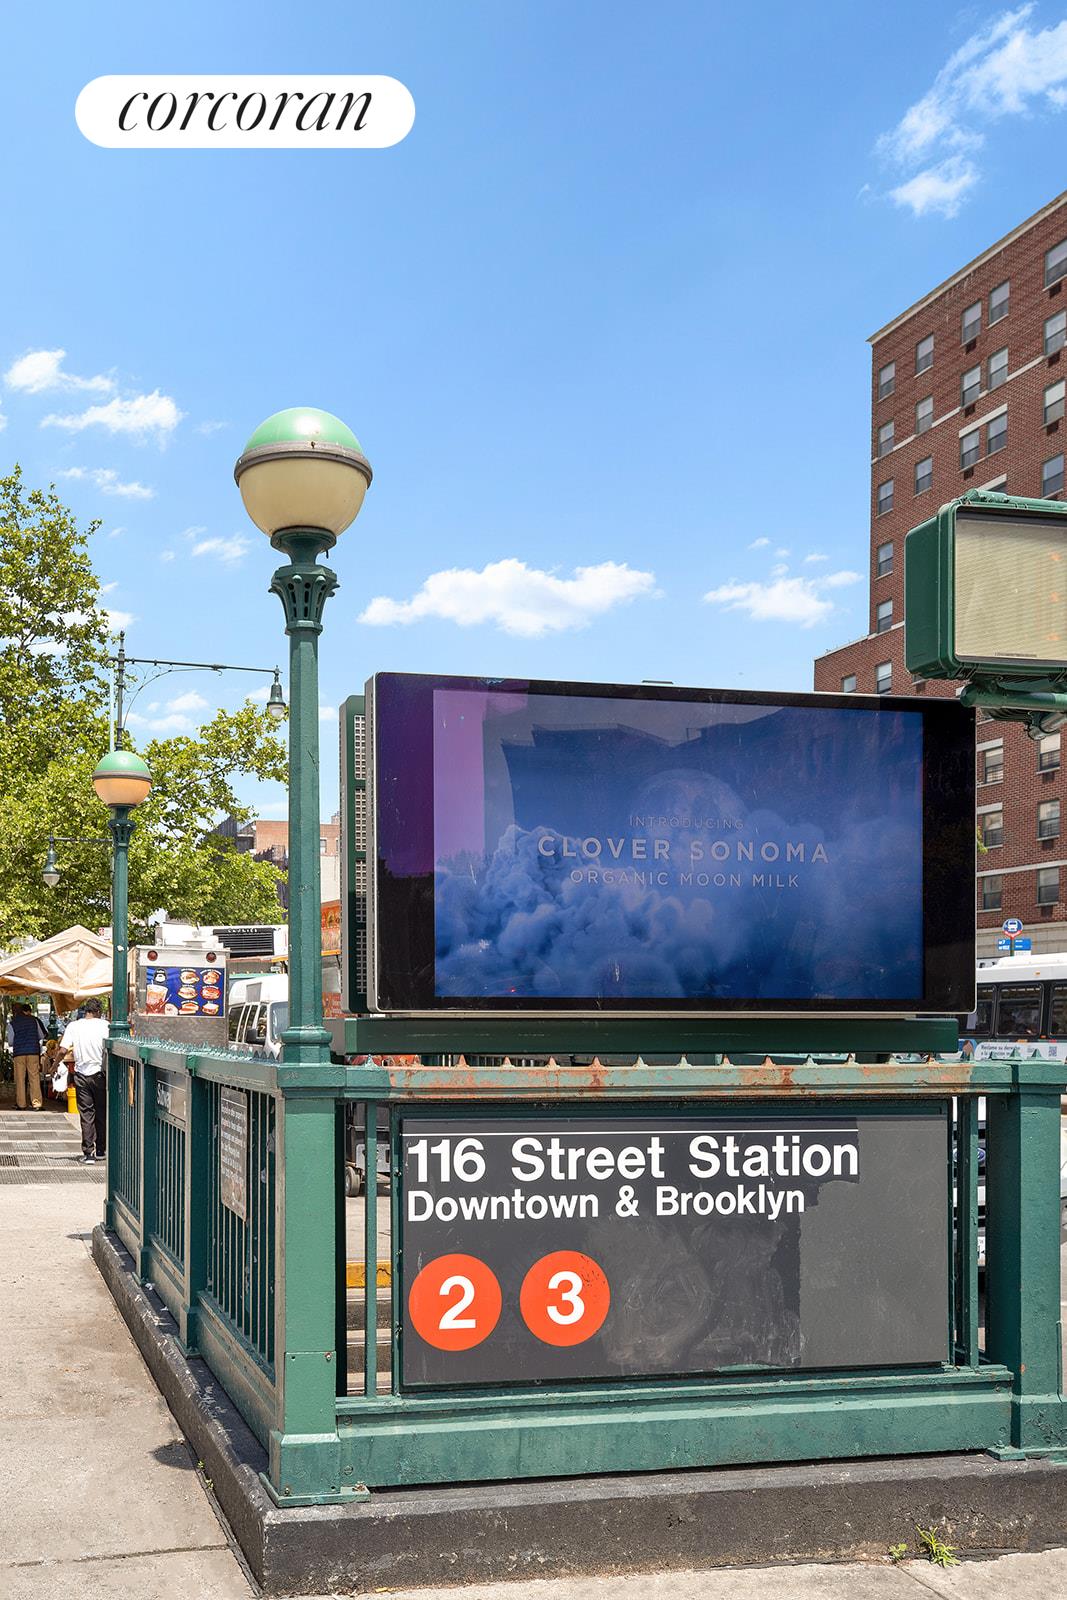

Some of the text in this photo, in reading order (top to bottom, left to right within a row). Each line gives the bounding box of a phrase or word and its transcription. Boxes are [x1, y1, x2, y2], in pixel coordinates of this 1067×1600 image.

[629, 815, 744, 830] INTRODUCING
[537, 835, 830, 864] CLOVER SONOMA
[570, 869, 799, 889] ORGANIC MOON MILK
[407, 1135, 859, 1184] 116 Street Station
[407, 1184, 806, 1222] Downtown & Brooklyn
[438, 1270, 586, 1330] 2 3
